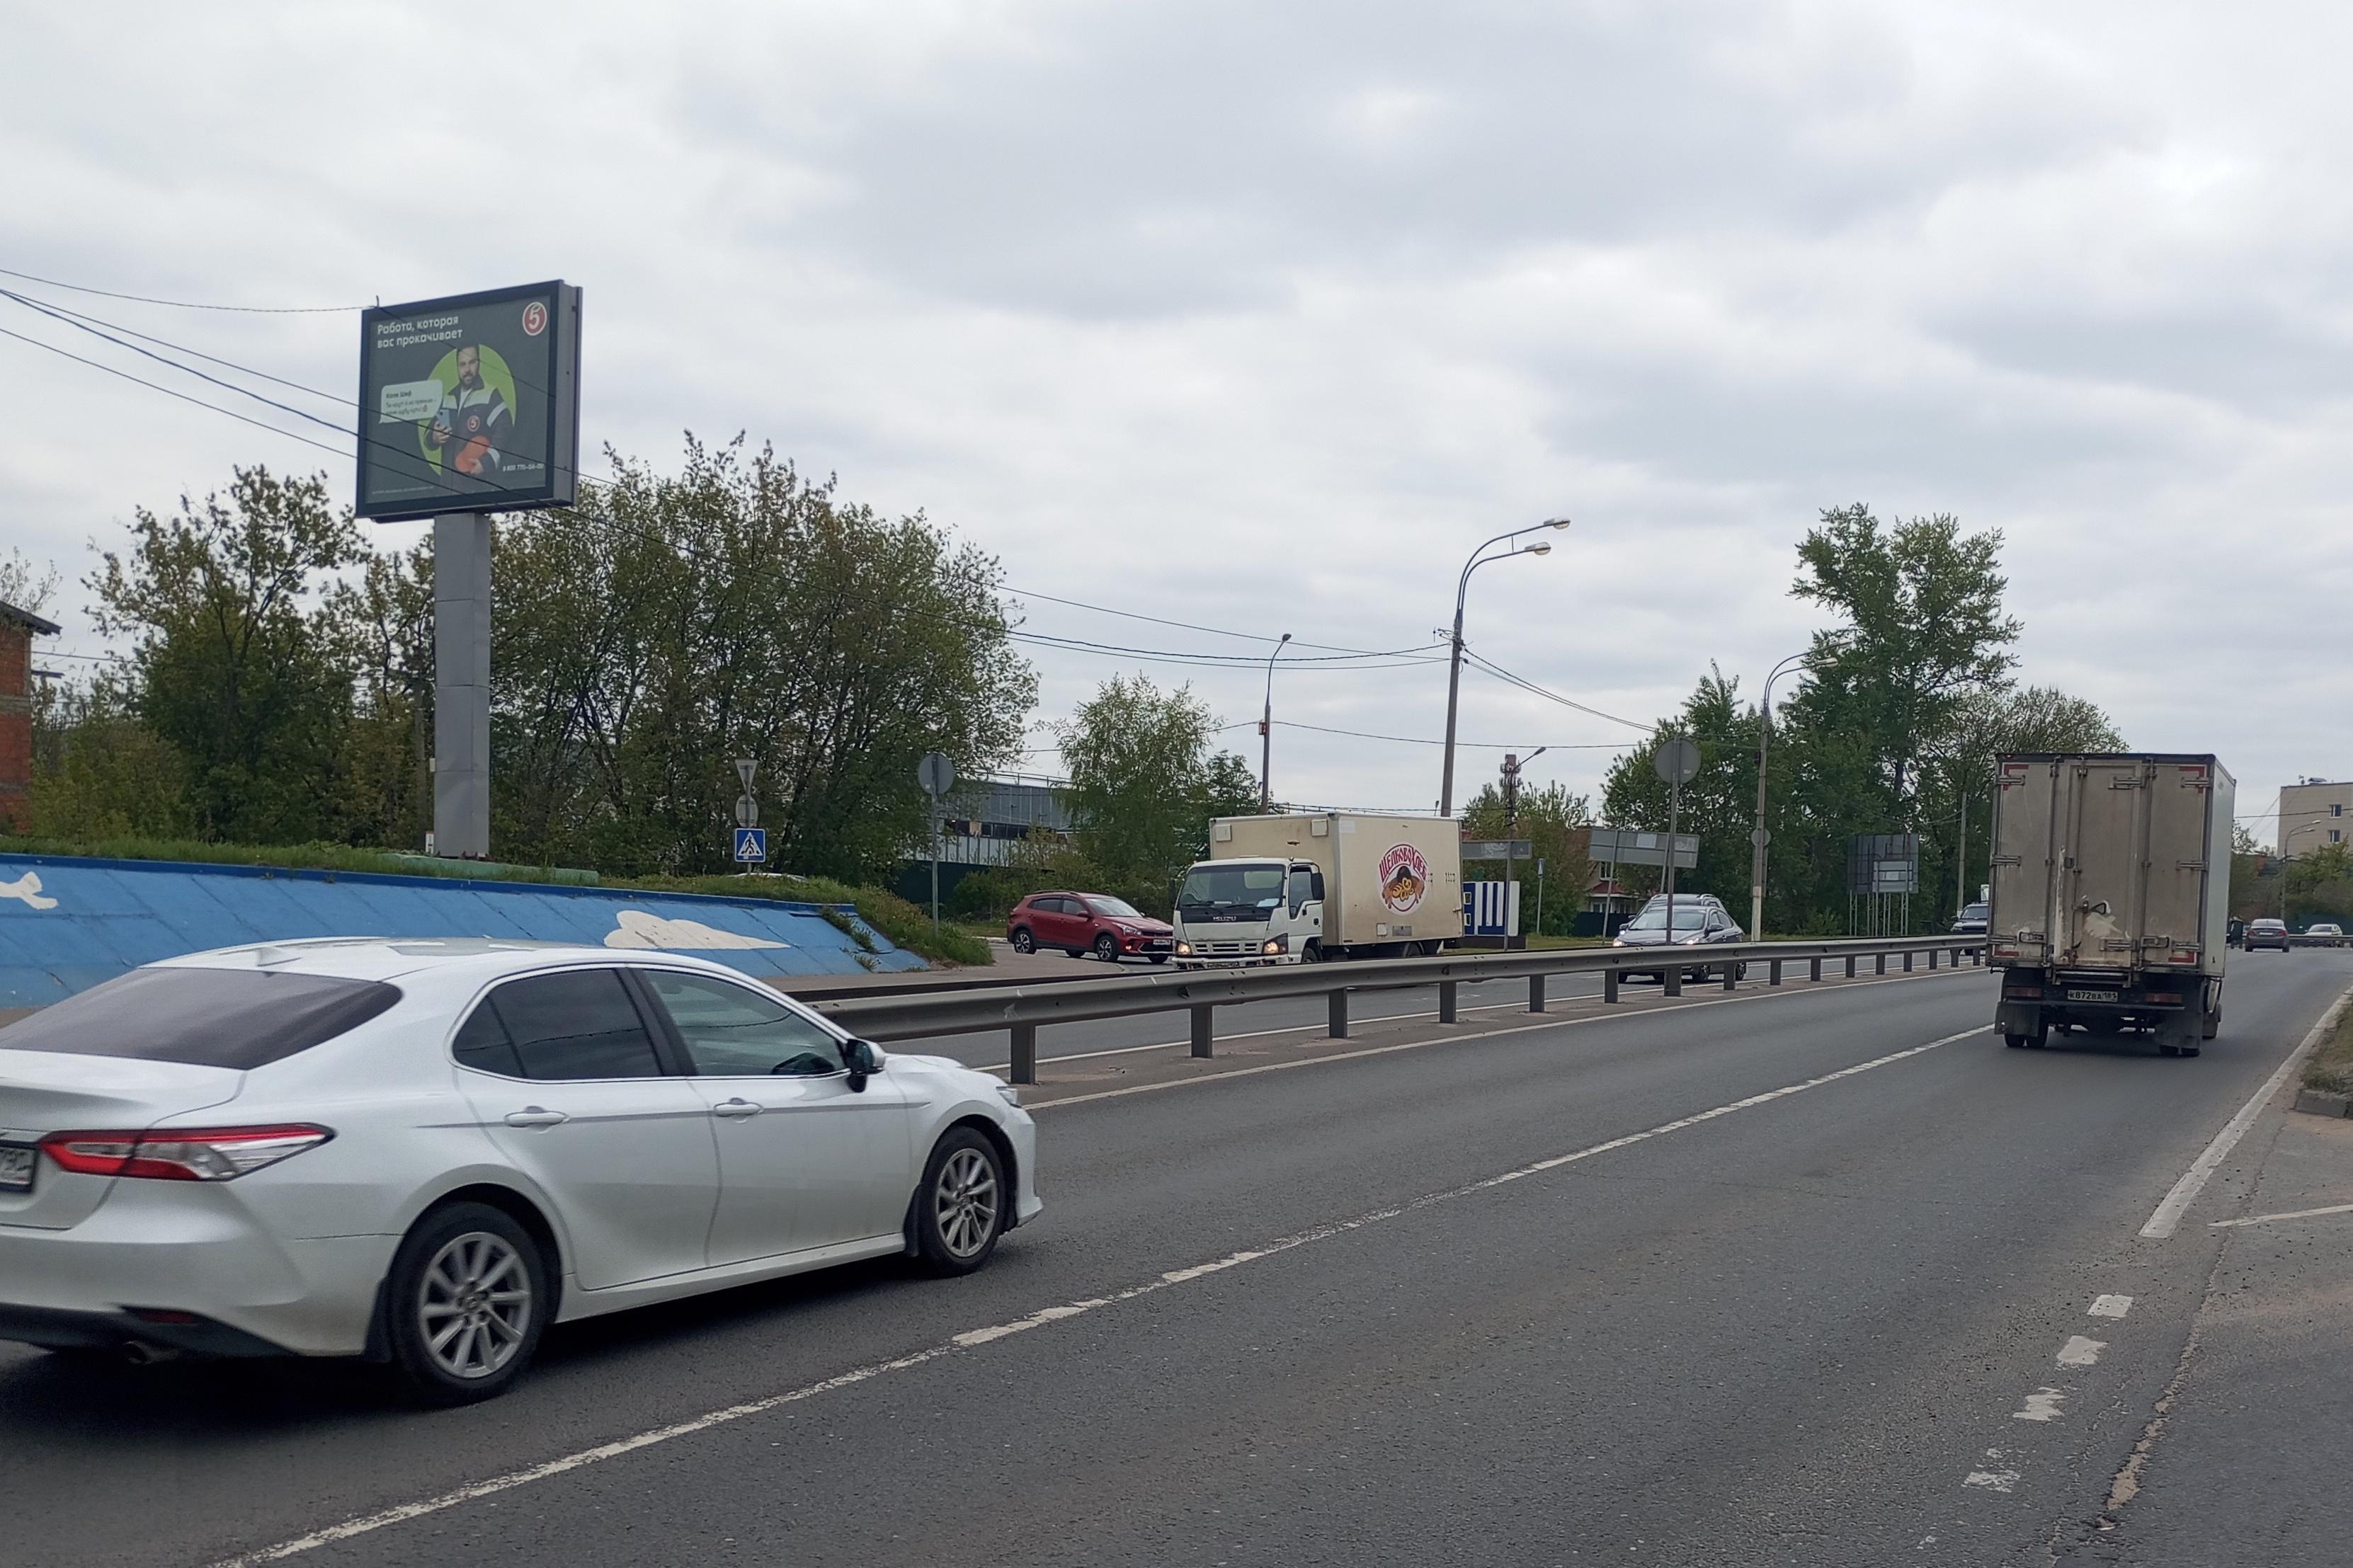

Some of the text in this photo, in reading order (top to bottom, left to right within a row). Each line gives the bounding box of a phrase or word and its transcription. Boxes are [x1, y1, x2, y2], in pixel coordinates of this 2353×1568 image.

[377, 316, 459, 335] Работа, которая
[377, 329, 462, 348] вас прокачивает
